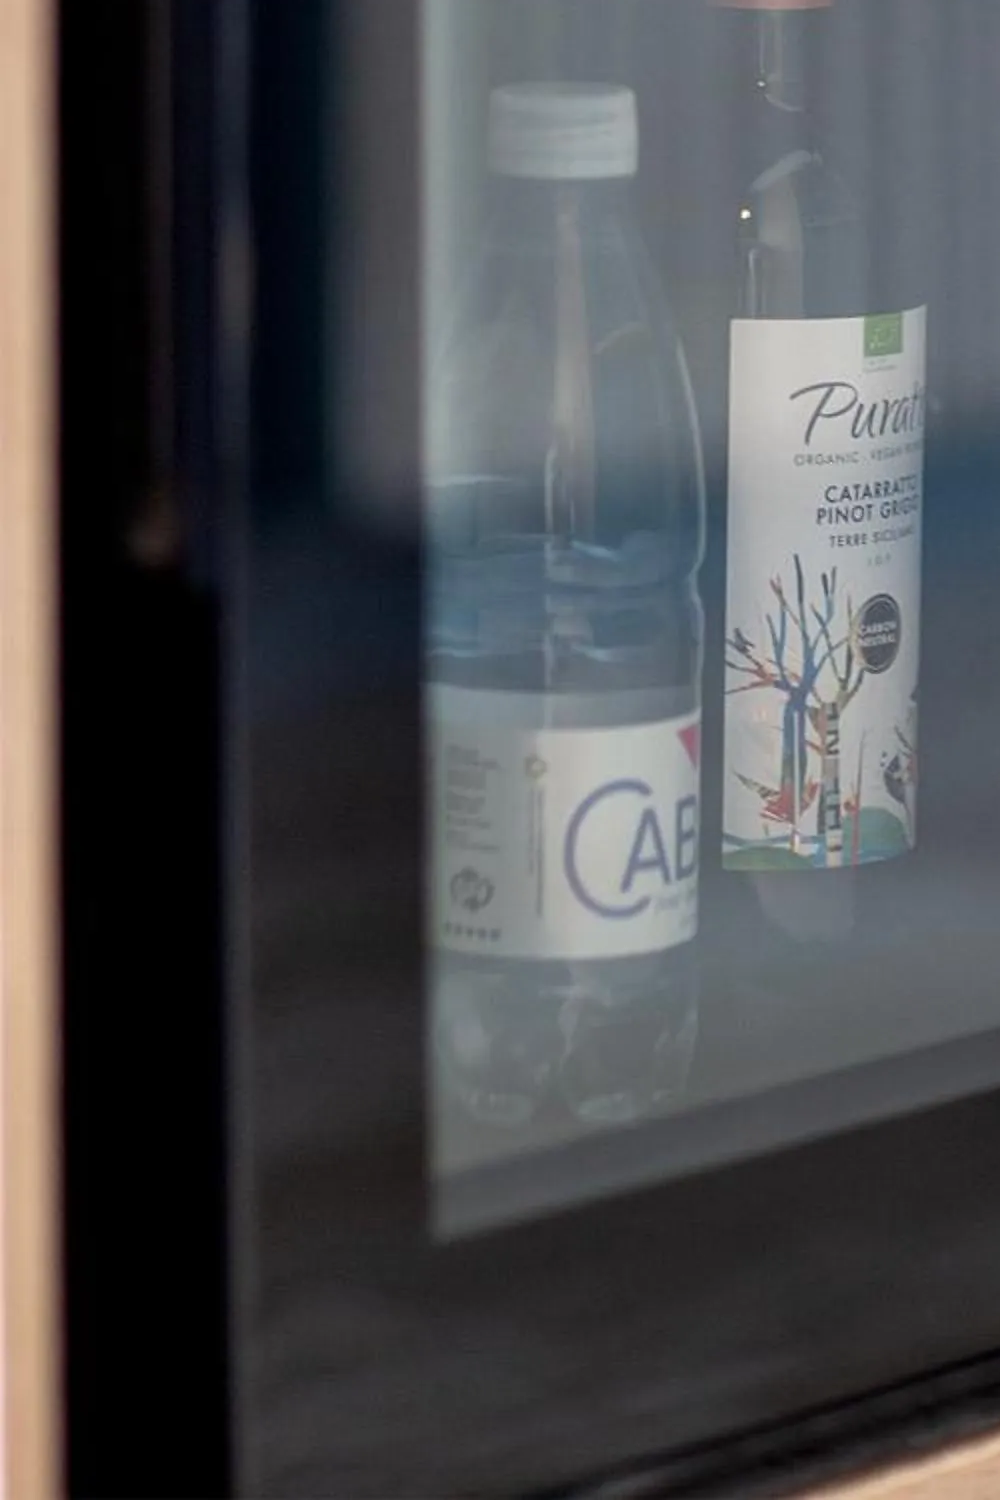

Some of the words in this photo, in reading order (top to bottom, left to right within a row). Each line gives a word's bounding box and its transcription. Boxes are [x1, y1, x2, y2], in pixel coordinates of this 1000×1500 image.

[788, 380, 923, 446] Purat
[793, 450, 860, 467] ORGANIC
[815, 503, 874, 526] PINOT
[828, 533, 868, 548] TERRE
